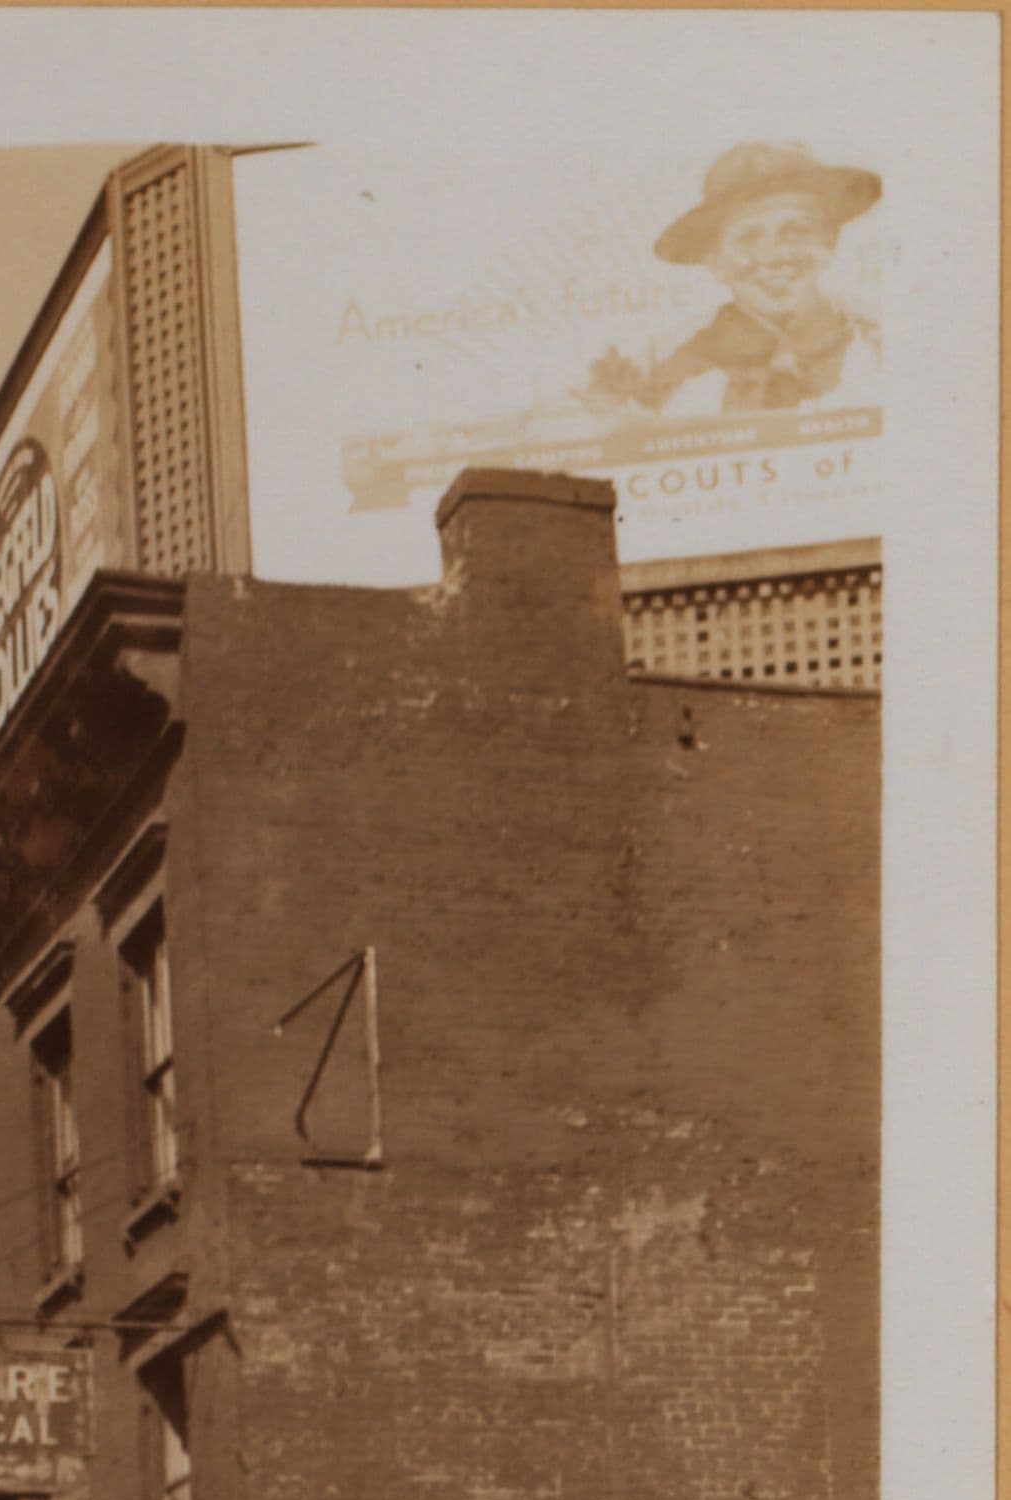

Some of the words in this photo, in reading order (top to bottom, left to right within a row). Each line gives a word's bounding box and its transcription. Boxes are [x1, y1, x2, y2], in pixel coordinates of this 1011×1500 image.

[644, 428, 756, 454] ADVENTURE
[798, 415, 870, 437] HEALTH
[626, 456, 779, 501] COUTS
[814, 447, 854, 480] of
